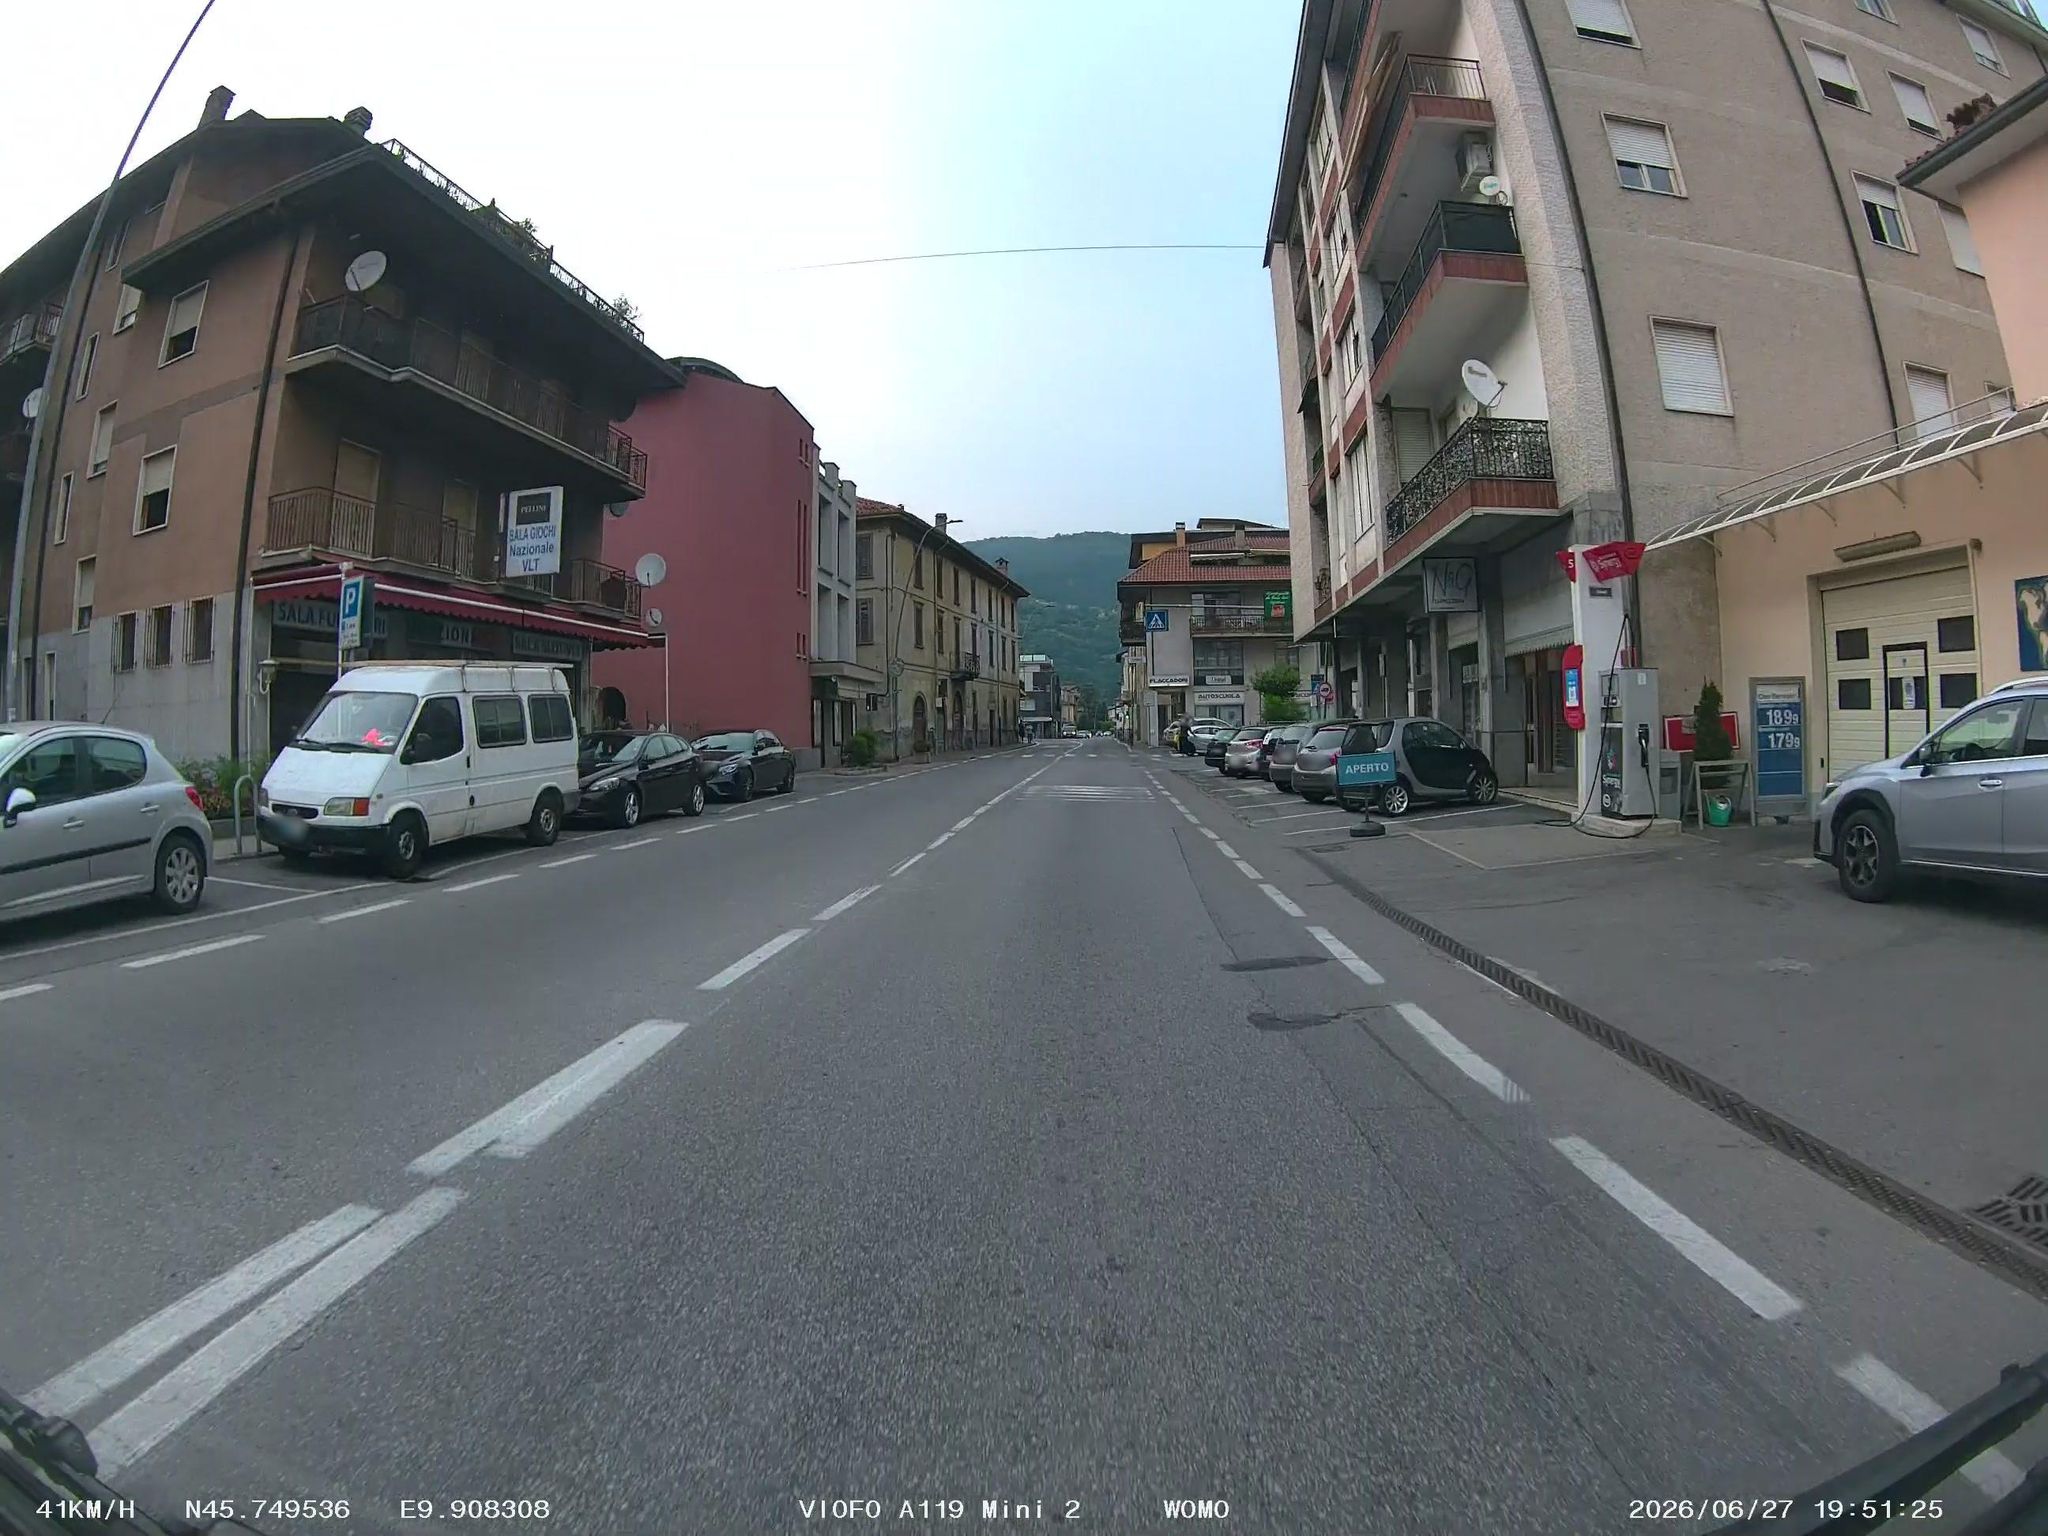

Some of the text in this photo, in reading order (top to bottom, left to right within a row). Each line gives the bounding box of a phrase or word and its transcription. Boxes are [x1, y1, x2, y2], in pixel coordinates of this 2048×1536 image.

[509, 525, 556, 542] SALA GIOCHI
[509, 541, 555, 557] Nazionale
[522, 558, 540, 572] VLT
[345, 587, 356, 615] P
[279, 601, 314, 624] SALA
[1345, 762, 1389, 775] APERTO
